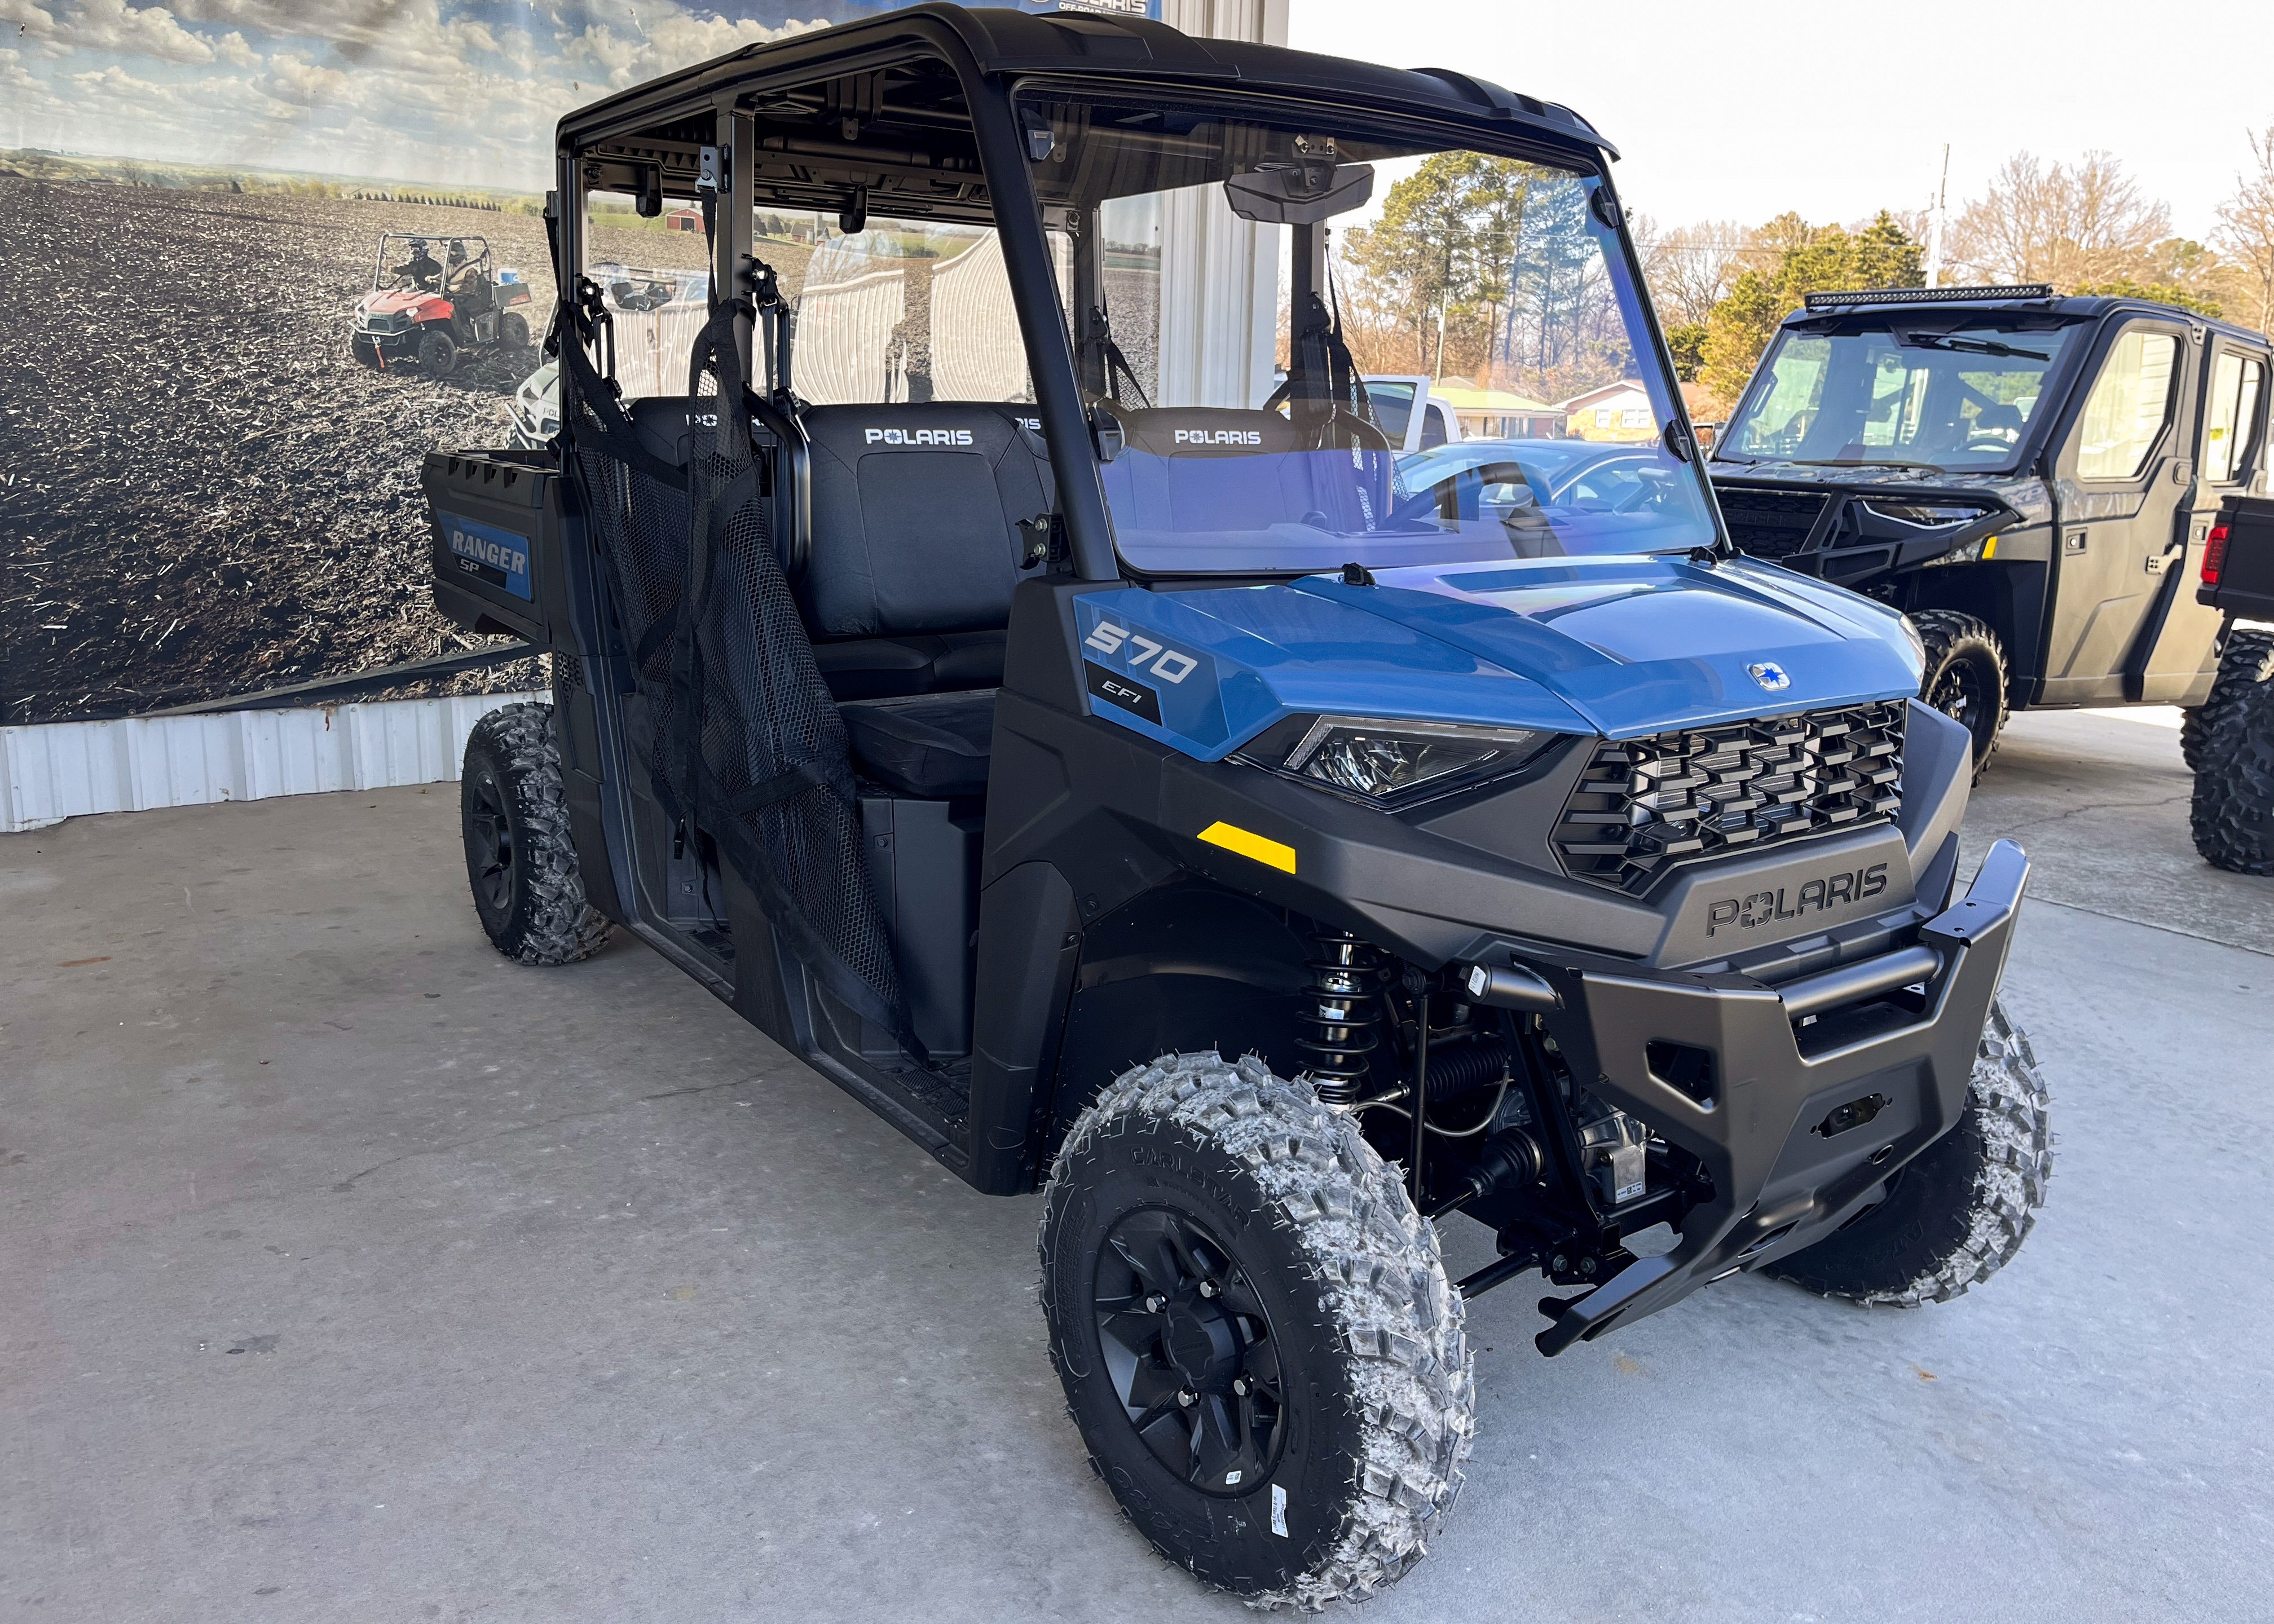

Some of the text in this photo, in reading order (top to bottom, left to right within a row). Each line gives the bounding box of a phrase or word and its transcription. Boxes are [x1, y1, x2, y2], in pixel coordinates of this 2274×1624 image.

[865, 429, 973, 445] POLARIS
[1174, 430, 1261, 445] POLARIS
[452, 530, 526, 575] RANGER
[460, 559, 479, 572] SP
[1084, 621, 1198, 684] 570
[1101, 680, 1142, 704] EFI
[1706, 863, 1888, 939] POLARIS
